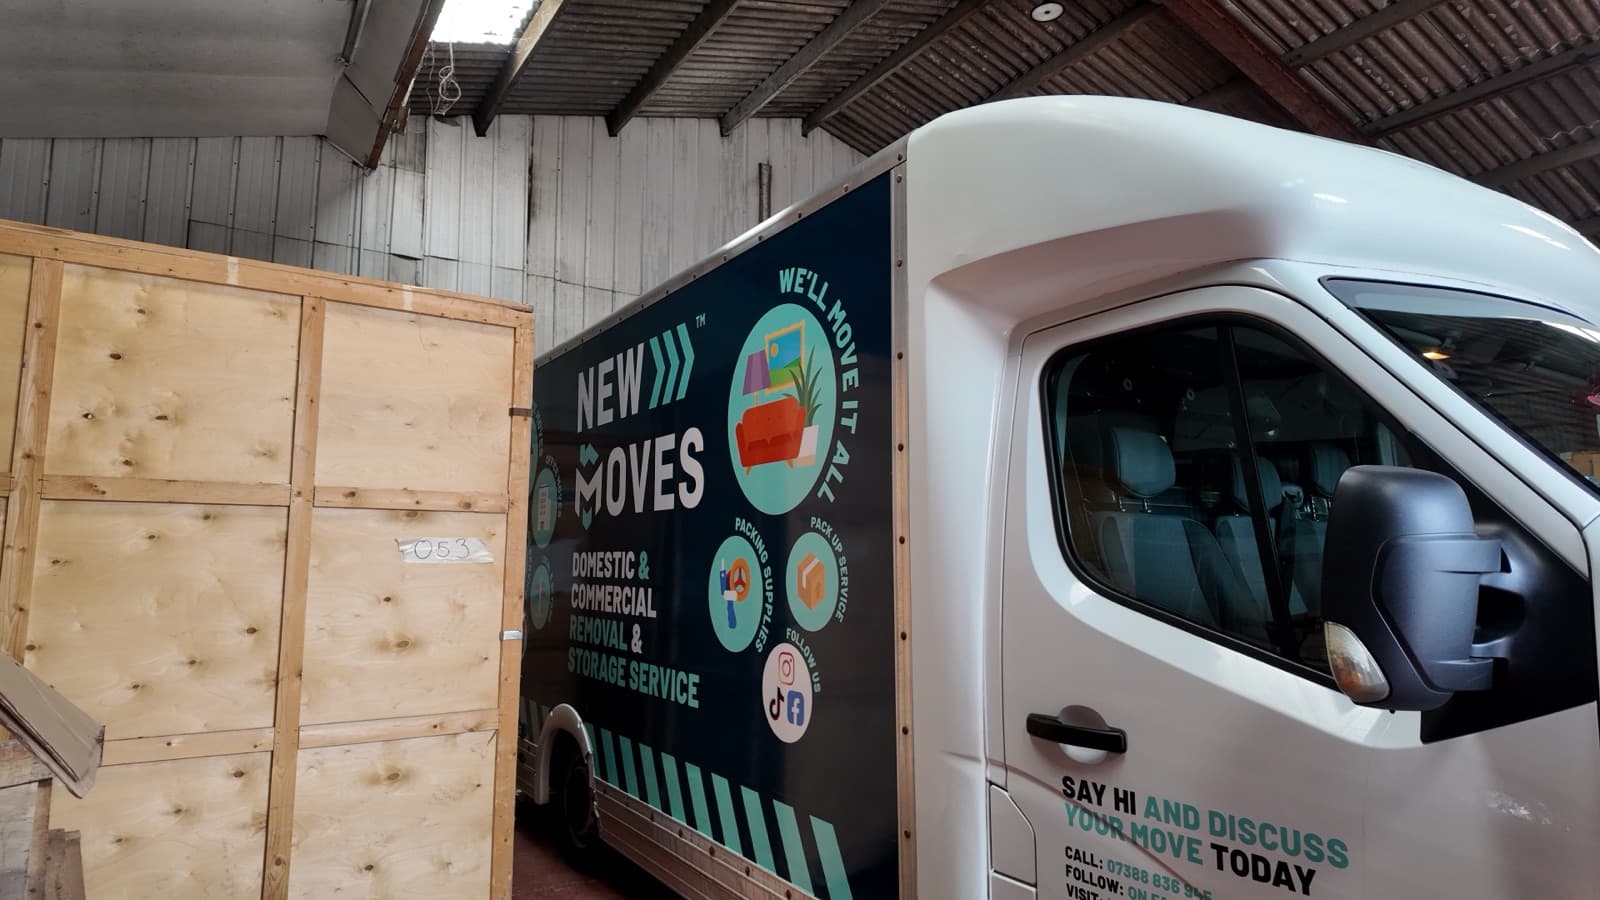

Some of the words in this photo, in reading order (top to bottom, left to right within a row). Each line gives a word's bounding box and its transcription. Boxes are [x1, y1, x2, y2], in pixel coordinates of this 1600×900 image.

[779, 267, 828, 312] WE'LL
[827, 299, 859, 392] MOVE
[577, 342, 645, 433] NEW
[841, 400, 858, 434] IT
[575, 427, 705, 518] MOVES
[817, 439, 850, 503] ALL
[414, 537, 471, 560] 053
[811, 516, 833, 538] PACK
[831, 535, 843, 553] UP
[572, 551, 635, 579] DOMESTIC
[638, 550, 650, 580] &
[735, 517, 769, 563] PACKING
[755, 566, 774, 653] SUPPLIES
[836, 556, 849, 623] SERVICE
[571, 583, 657, 618] COMMERCIAL
[569, 614, 628, 651] REMOVAL
[631, 623, 642, 654] &
[567, 646, 627, 688] STORAGE
[629, 660, 700, 709] SERVICE
[786, 627, 816, 669] FOLLOW
[812, 672, 821, 693] US
[1062, 775, 1107, 806] SAY
[1113, 787, 1136, 815] HI
[1144, 795, 1200, 831] AND
[1208, 809, 1350, 869] DISCUSS
[1064, 803, 1125, 842] YOUR
[1130, 821, 1203, 865] MOVE
[1210, 842, 1316, 896] TODAY
[1065, 846, 1103, 870] CALL:
[1107, 859, 1149, 884] 07388
[1152, 873, 1180, 895] 836
[1065, 864, 1124, 897] FOLLOW:
[1127, 886, 1147, 900] ON
[1066, 883, 1103, 900] VISIT
